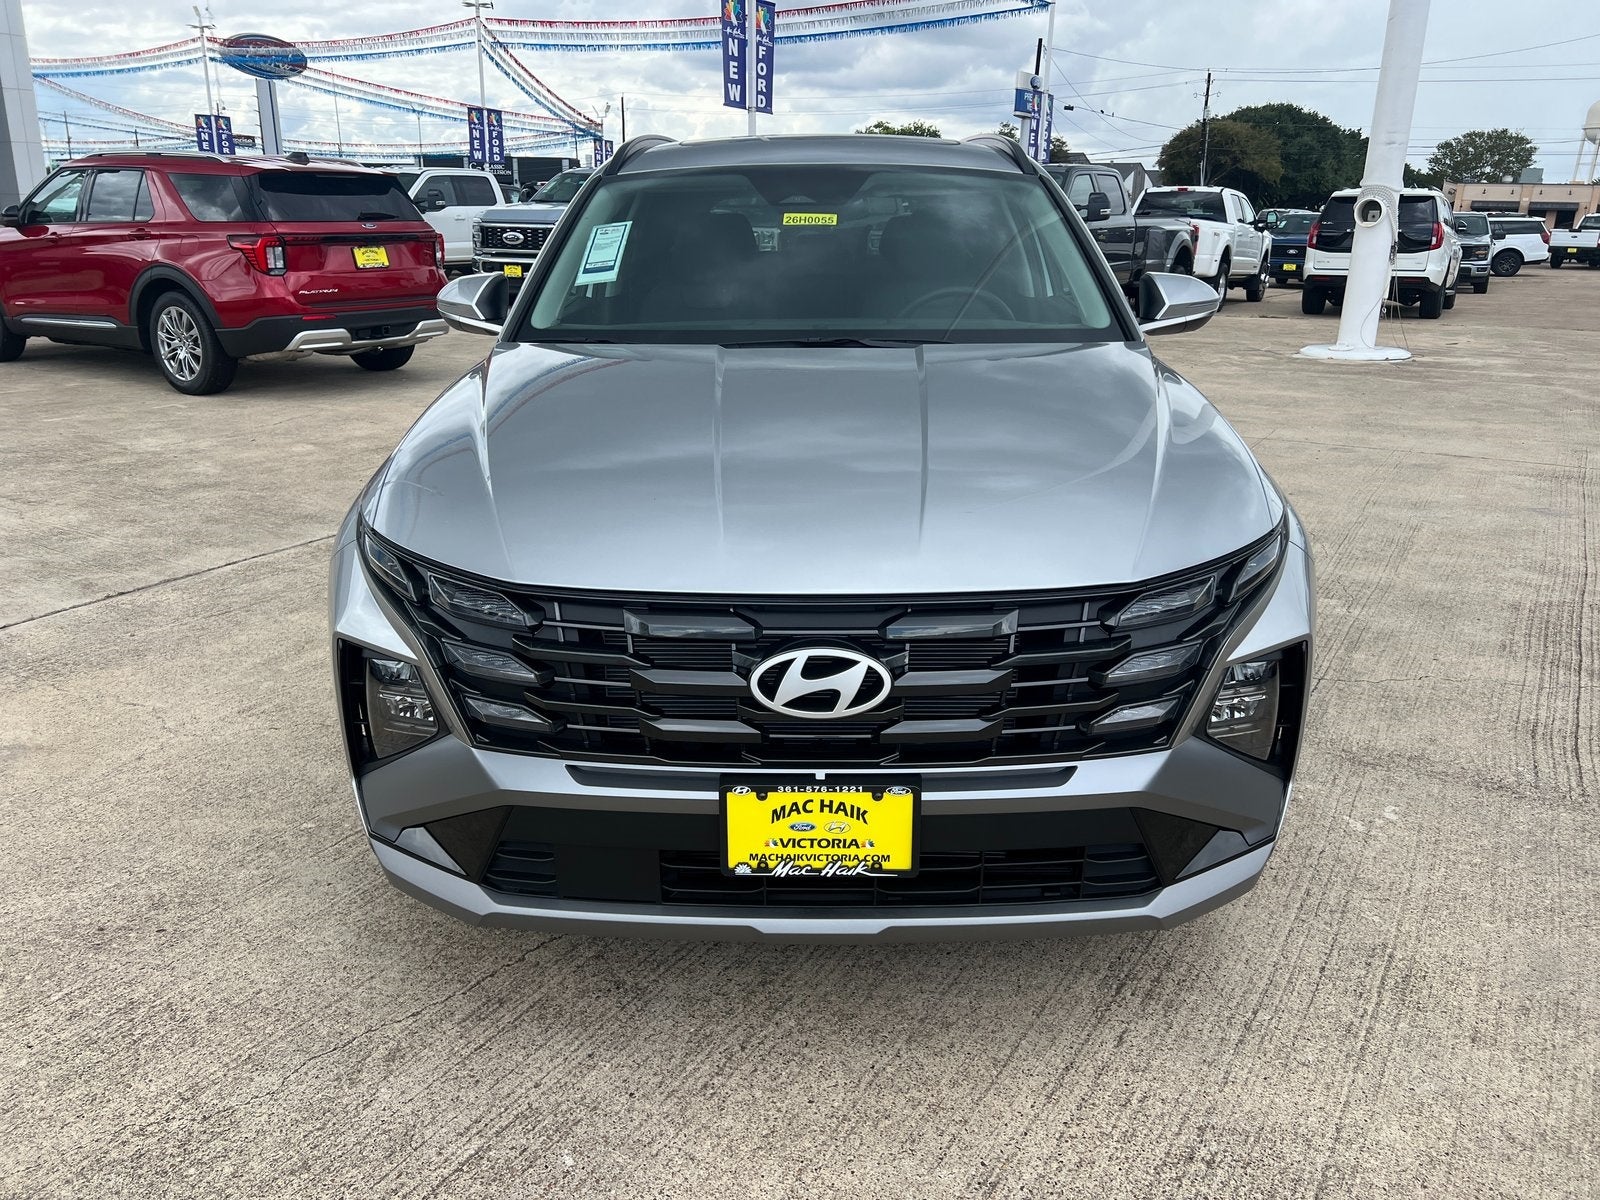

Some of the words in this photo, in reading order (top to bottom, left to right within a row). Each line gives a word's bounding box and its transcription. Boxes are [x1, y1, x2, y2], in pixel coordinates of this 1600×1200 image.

[728, 37, 741, 102] NEW
[757, 46, 767, 108] FORD
[201, 132, 210, 150] NE
[221, 134, 231, 154] FOR
[472, 129, 482, 160] NEW
[492, 131, 501, 161] FORD
[1029, 119, 1037, 158] NEW
[785, 216, 834, 224] 26H0055
[777, 785, 863, 793] 361-576-1221
[770, 799, 814, 825] MAC
[819, 799, 869, 826] HAIK
[779, 838, 861, 849] VICTORIA
[749, 853, 891, 863] MACHAIKVICTORIA.COM
[770, 860, 819, 878] Mac
[820, 860, 876, 878] Haik
